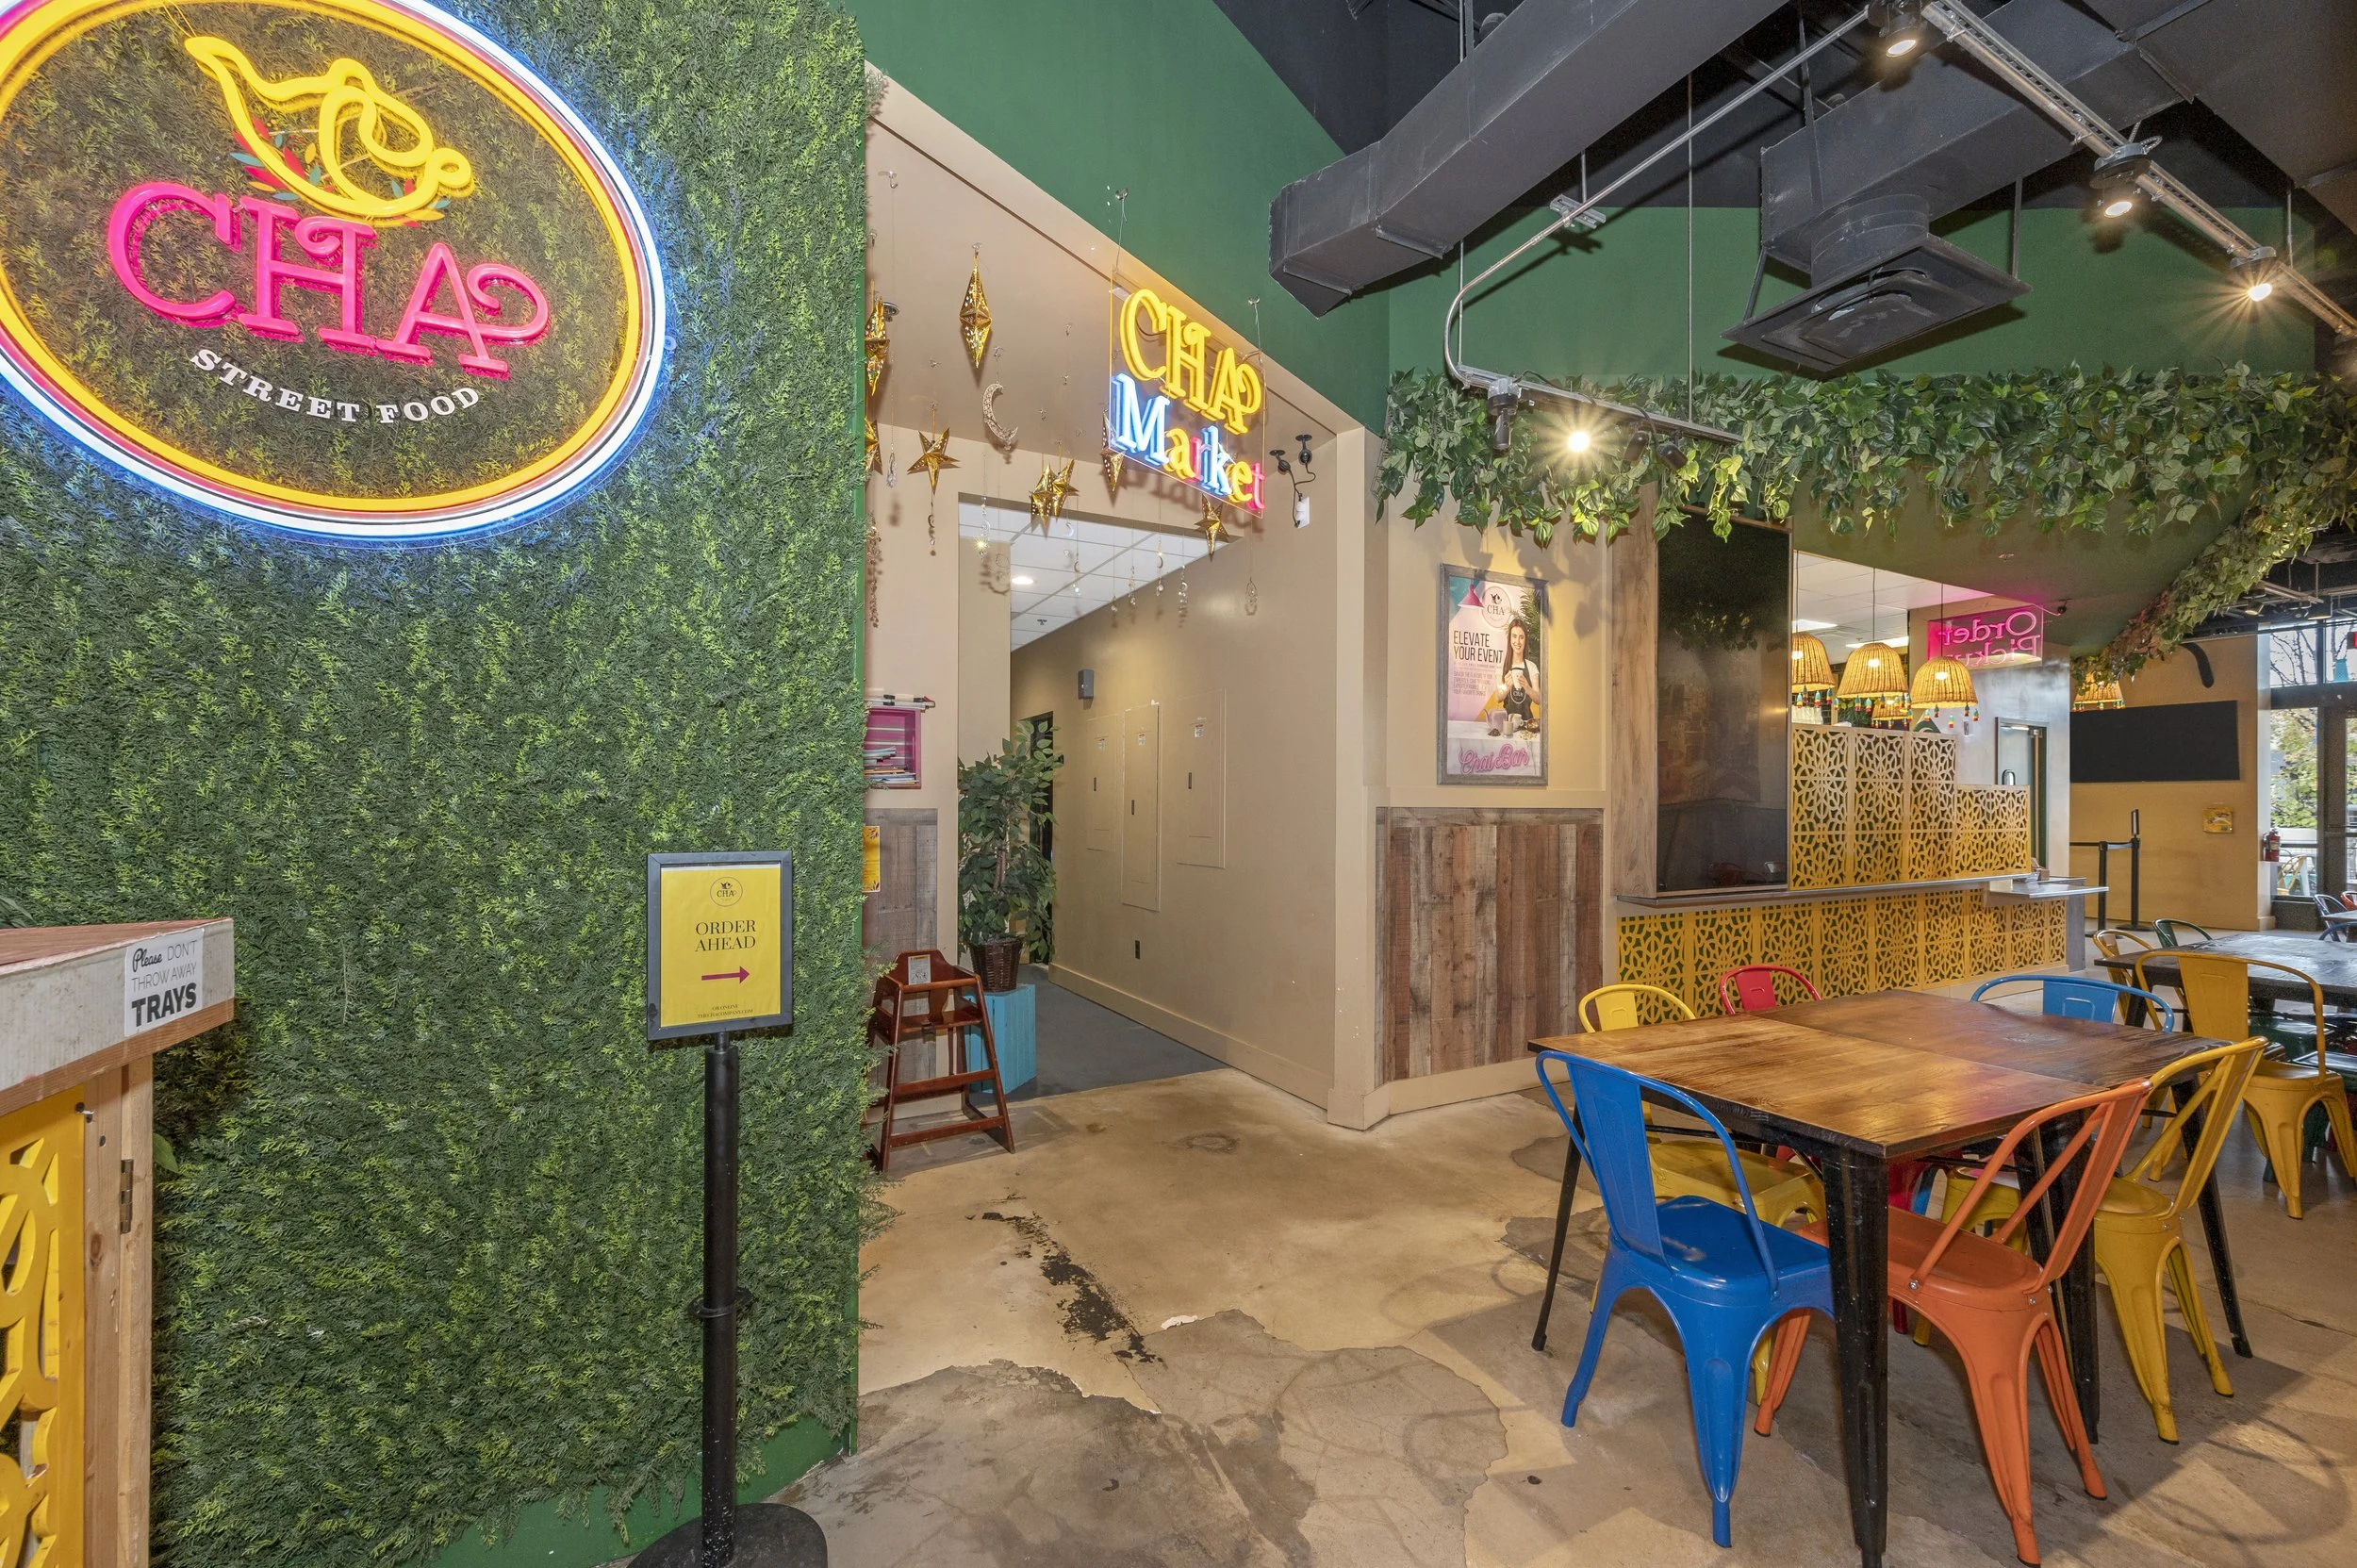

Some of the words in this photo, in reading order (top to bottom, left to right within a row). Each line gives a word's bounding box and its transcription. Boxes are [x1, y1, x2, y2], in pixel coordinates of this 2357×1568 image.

[108, 182, 552, 376] CHA
[1119, 289, 1262, 435] CHA
[190, 349, 361, 422] STREET
[376, 388, 479, 423] FOOD
[1111, 372, 1266, 511] Market
[1487, 604, 1505, 616] CHA
[1453, 630, 1491, 648] ELEVATE
[1453, 646, 1476, 662] YOUR
[1477, 648, 1504, 664] EVENT
[1459, 747, 1494, 774] Chai
[1494, 743, 1529, 769] Bar
[717, 889, 737, 898] CHA
[695, 919, 757, 936] ORDER
[695, 935, 756, 952] AHEAD
[132, 948, 162, 973] Please
[131, 968, 171, 993] THROW
[171, 962, 197, 982] AWAY
[131, 982, 197, 1028] TRAYS
